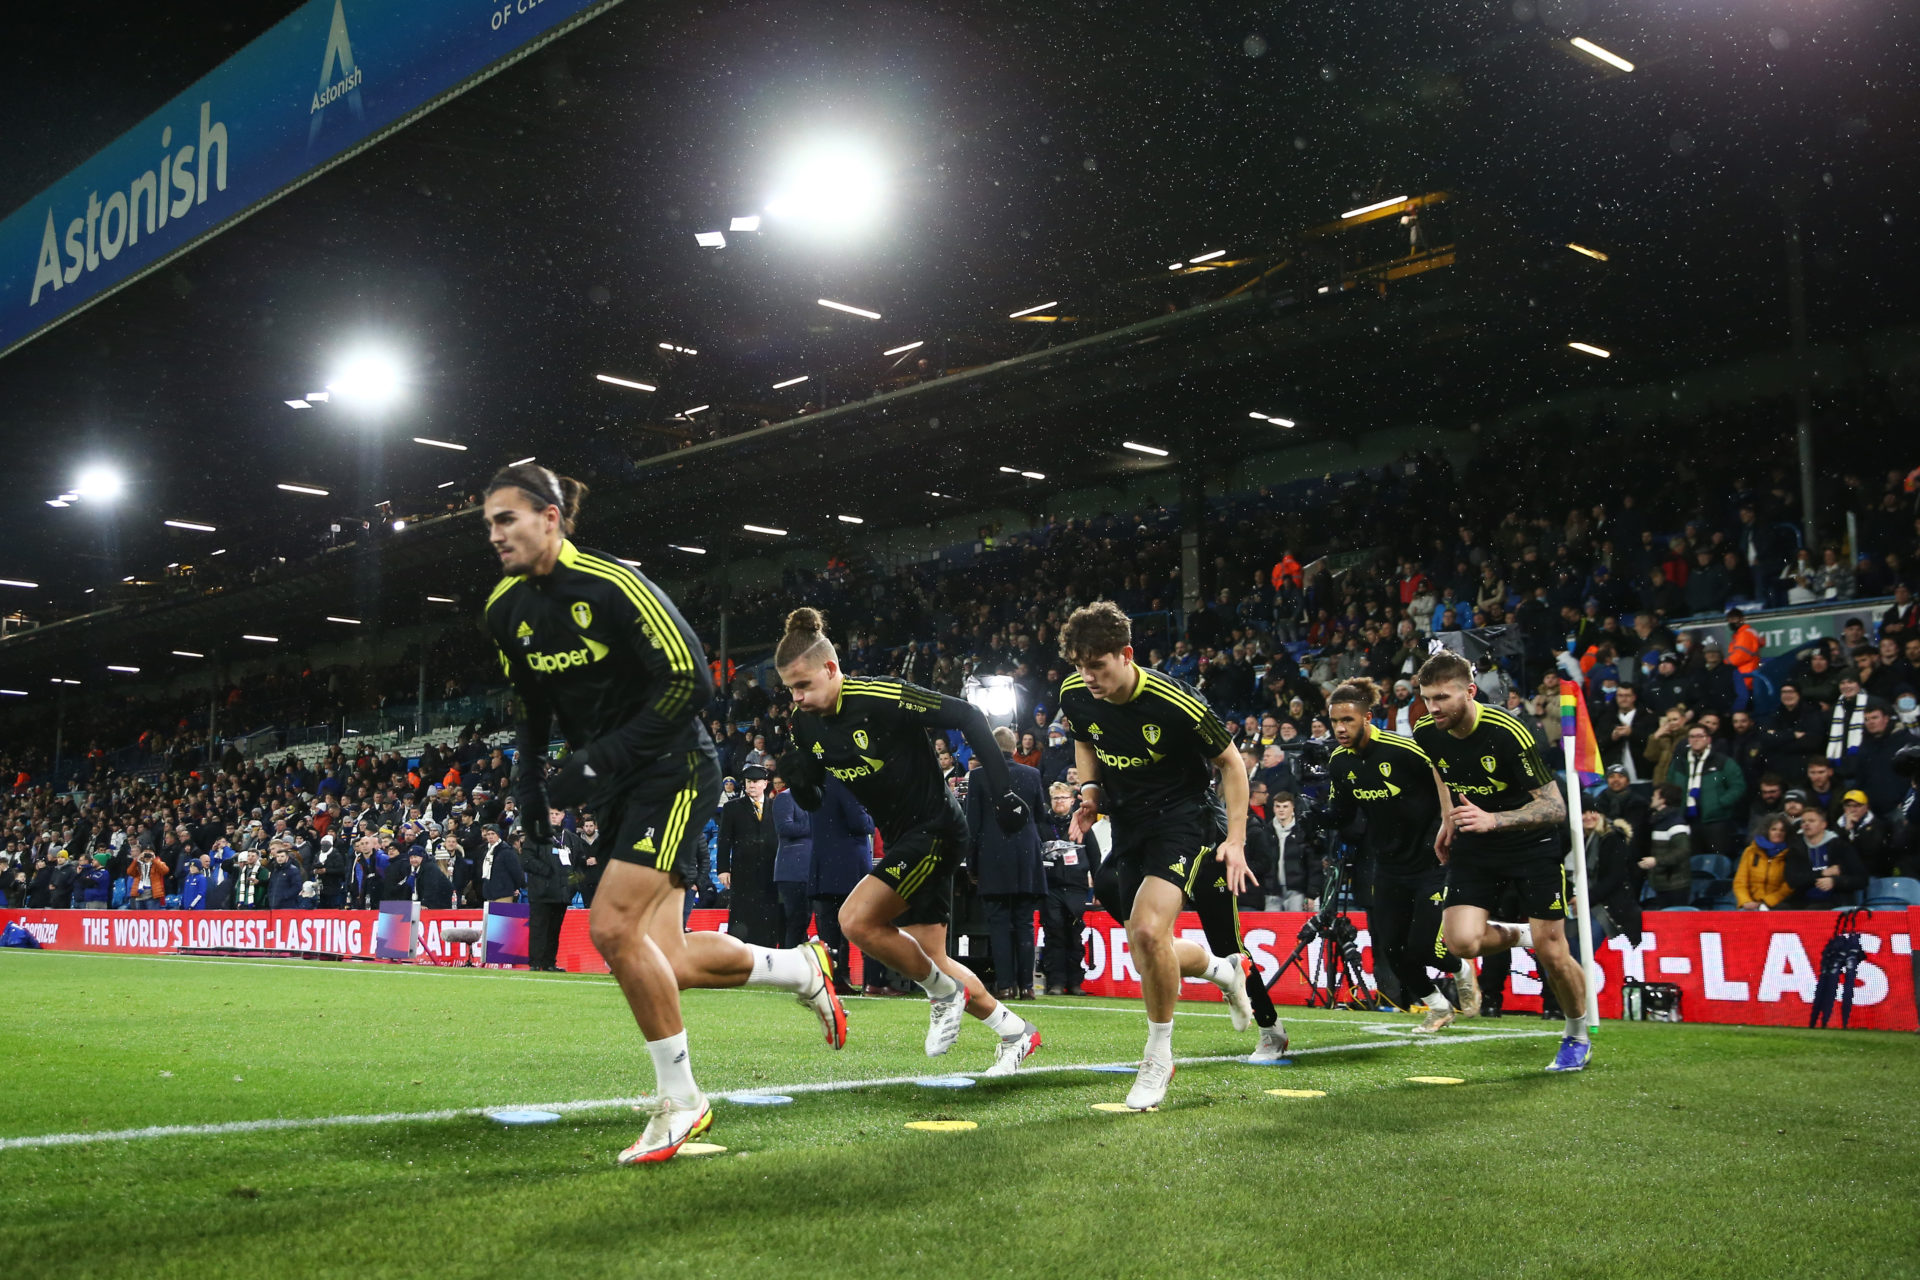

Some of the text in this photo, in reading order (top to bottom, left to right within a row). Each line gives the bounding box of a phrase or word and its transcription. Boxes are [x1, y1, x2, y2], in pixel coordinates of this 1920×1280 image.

[491, 3, 512, 31] OF
[310, 65, 362, 114] Astonish
[29, 101, 228, 306] Astonish
[526, 648, 589, 674] Clipper
[82, 918, 109, 946] THE
[114, 918, 183, 948] WORLD'S
[188, 918, 362, 954] LONGEST-LASTING
